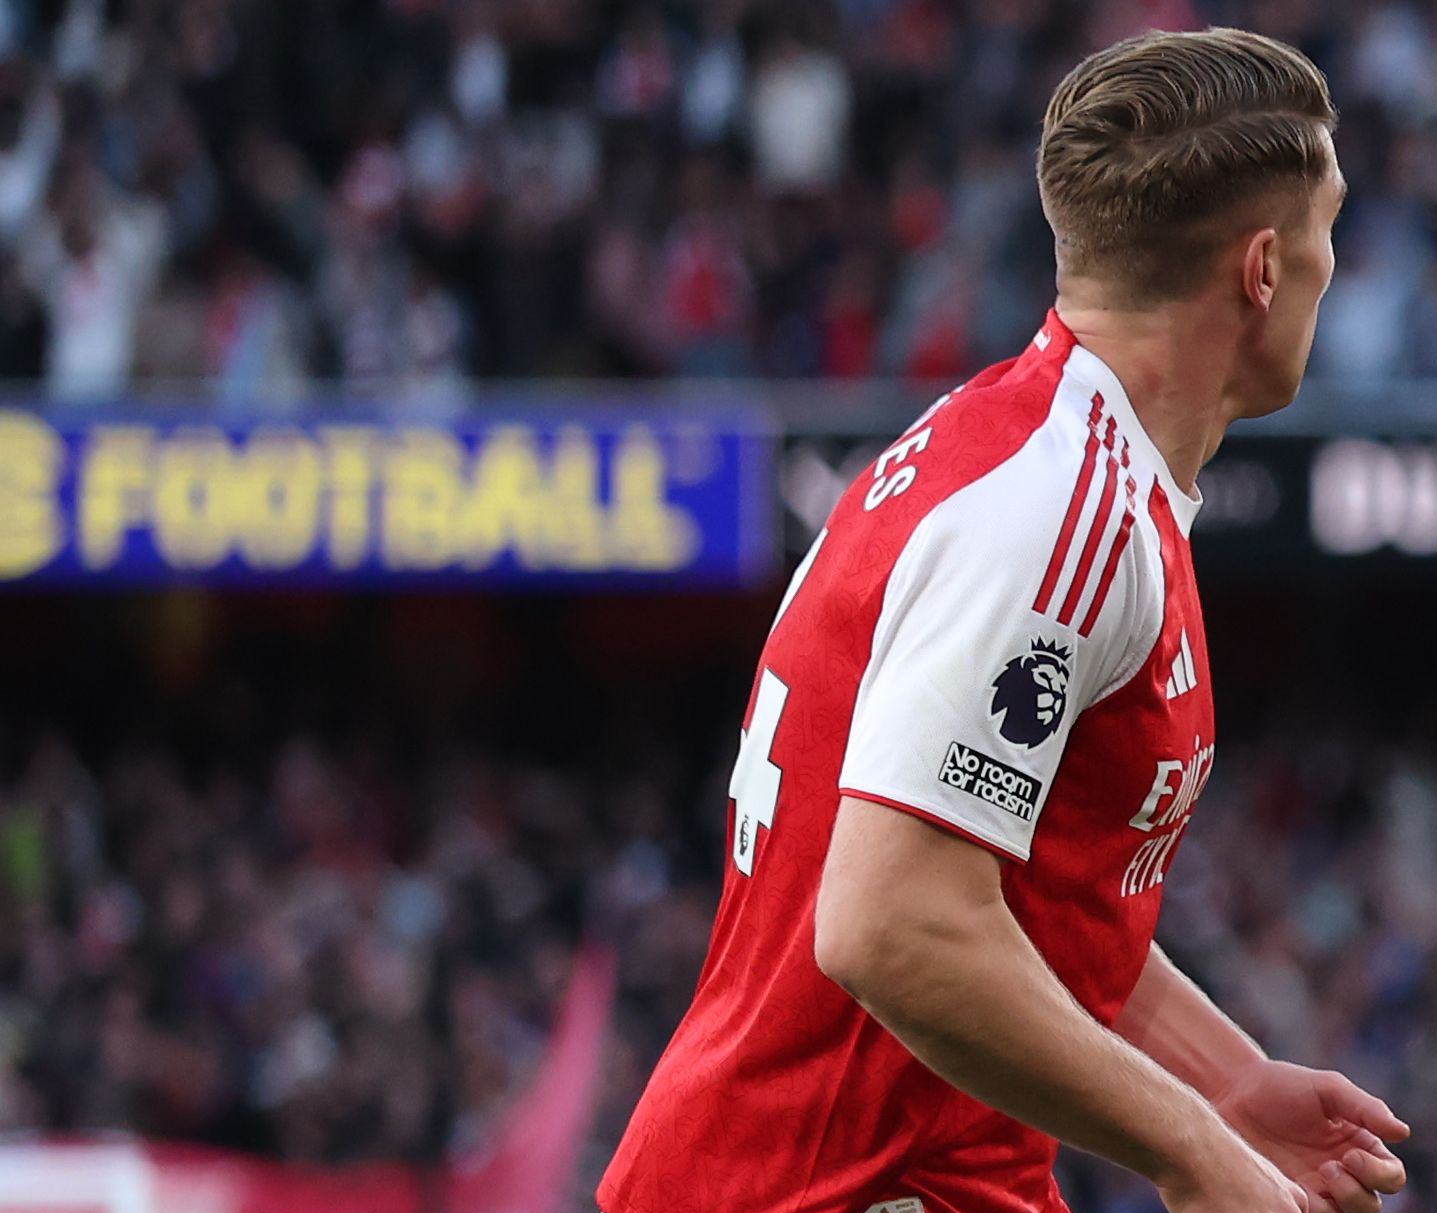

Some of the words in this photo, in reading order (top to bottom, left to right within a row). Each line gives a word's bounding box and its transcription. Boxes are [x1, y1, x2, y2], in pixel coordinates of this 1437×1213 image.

[78, 420, 703, 573] FOOTBALL
[864, 395, 950, 512] ES
[939, 760, 975, 790] for
[973, 778, 1034, 821] racism
[945, 742, 980, 773] No
[980, 761, 1033, 800] room
